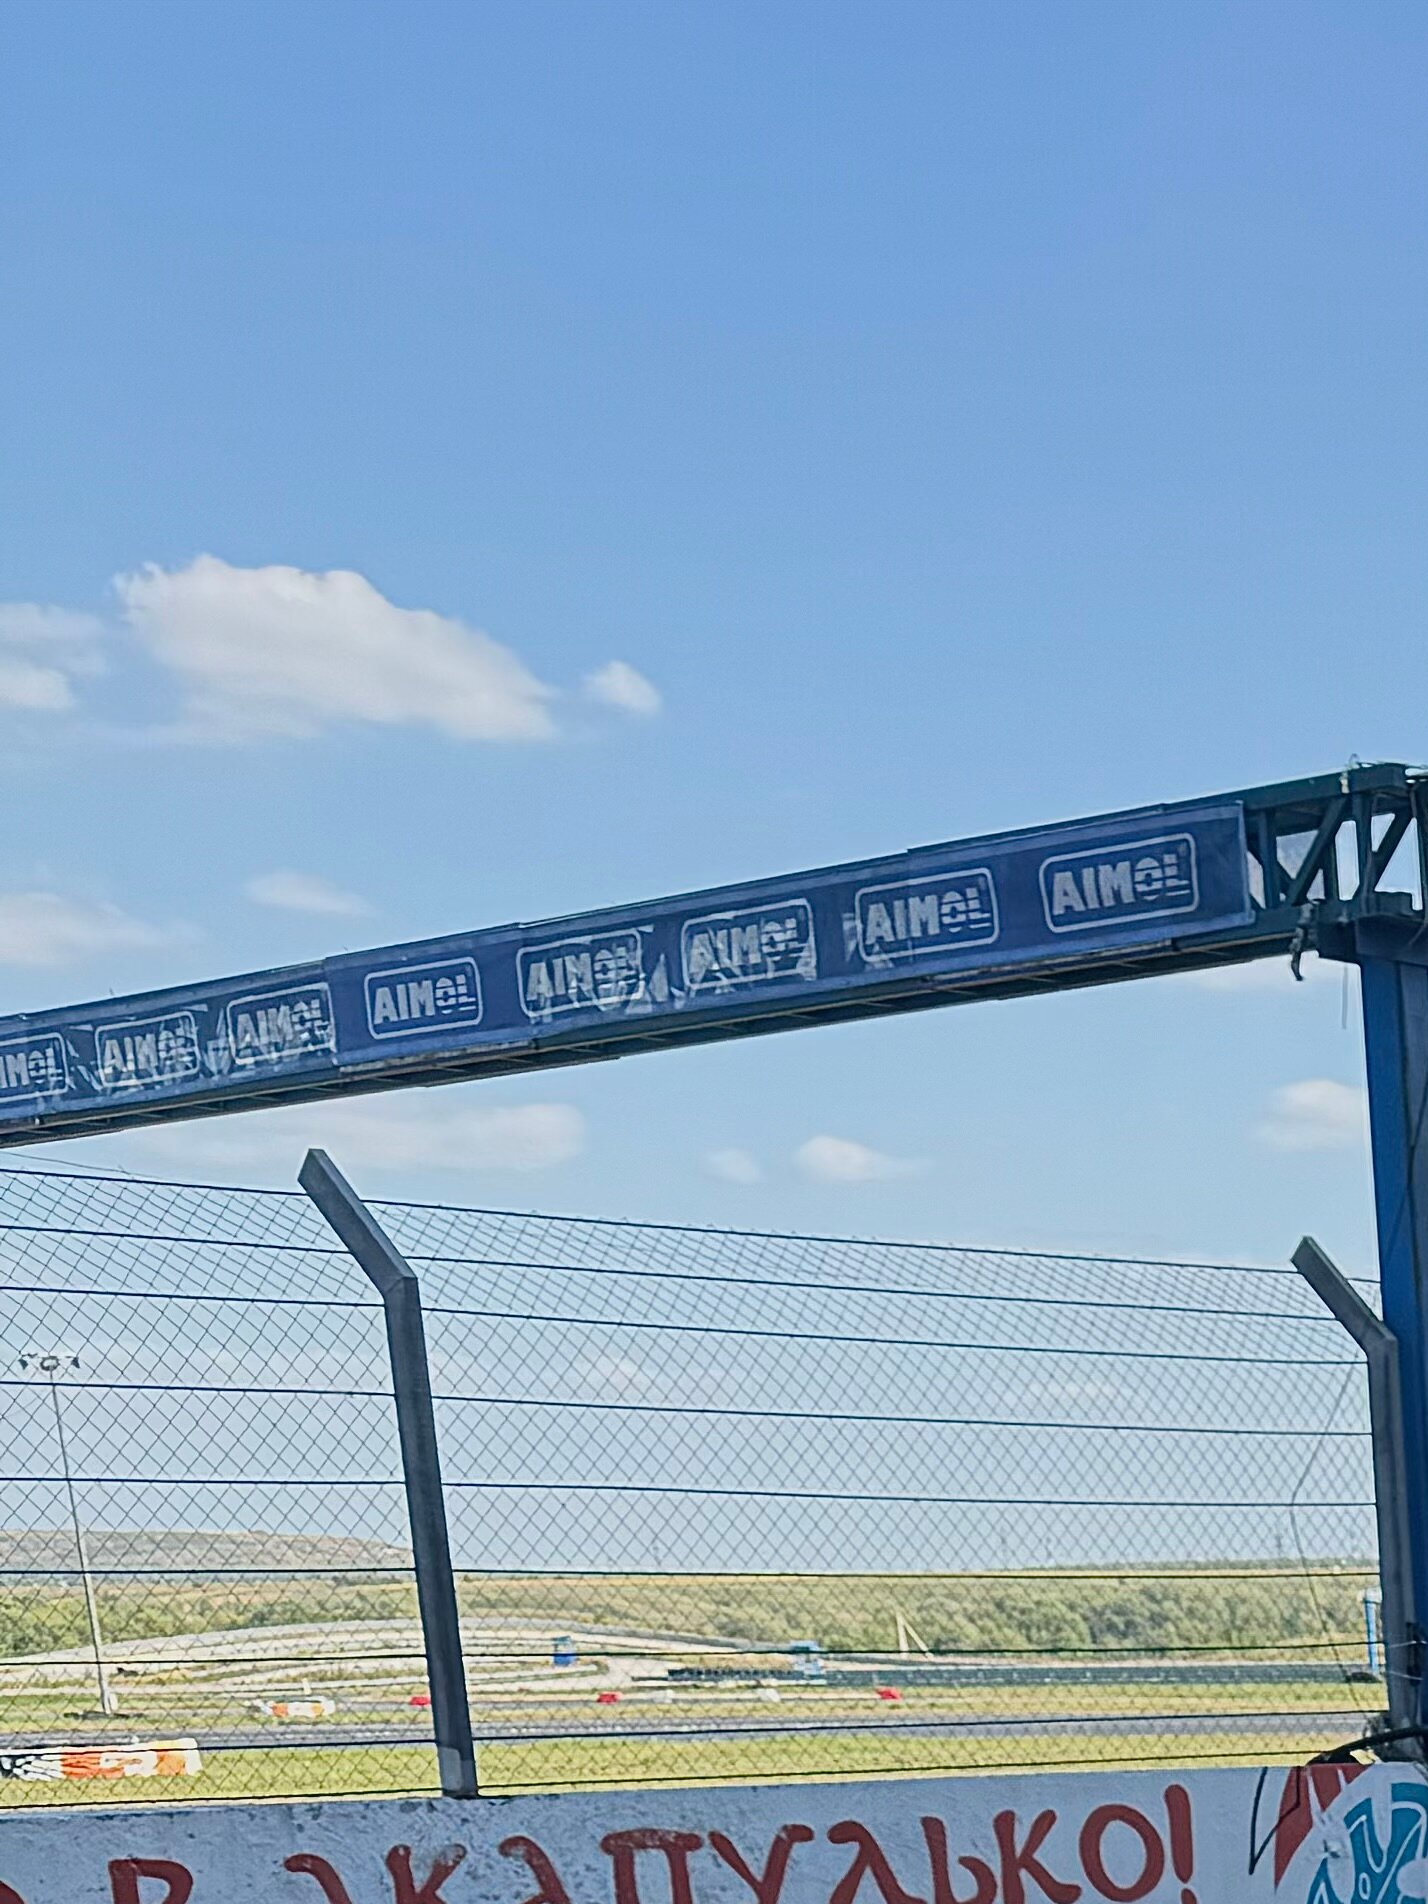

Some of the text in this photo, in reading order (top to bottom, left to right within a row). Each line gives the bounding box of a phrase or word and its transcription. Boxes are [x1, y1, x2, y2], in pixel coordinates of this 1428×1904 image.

[1052, 851, 1192, 917] AIMOL
[866, 886, 993, 946] AIMOL
[690, 917, 797, 979] AIMOL
[373, 973, 477, 1025] AIMOL
[0, 1047, 64, 1090] IMOL
